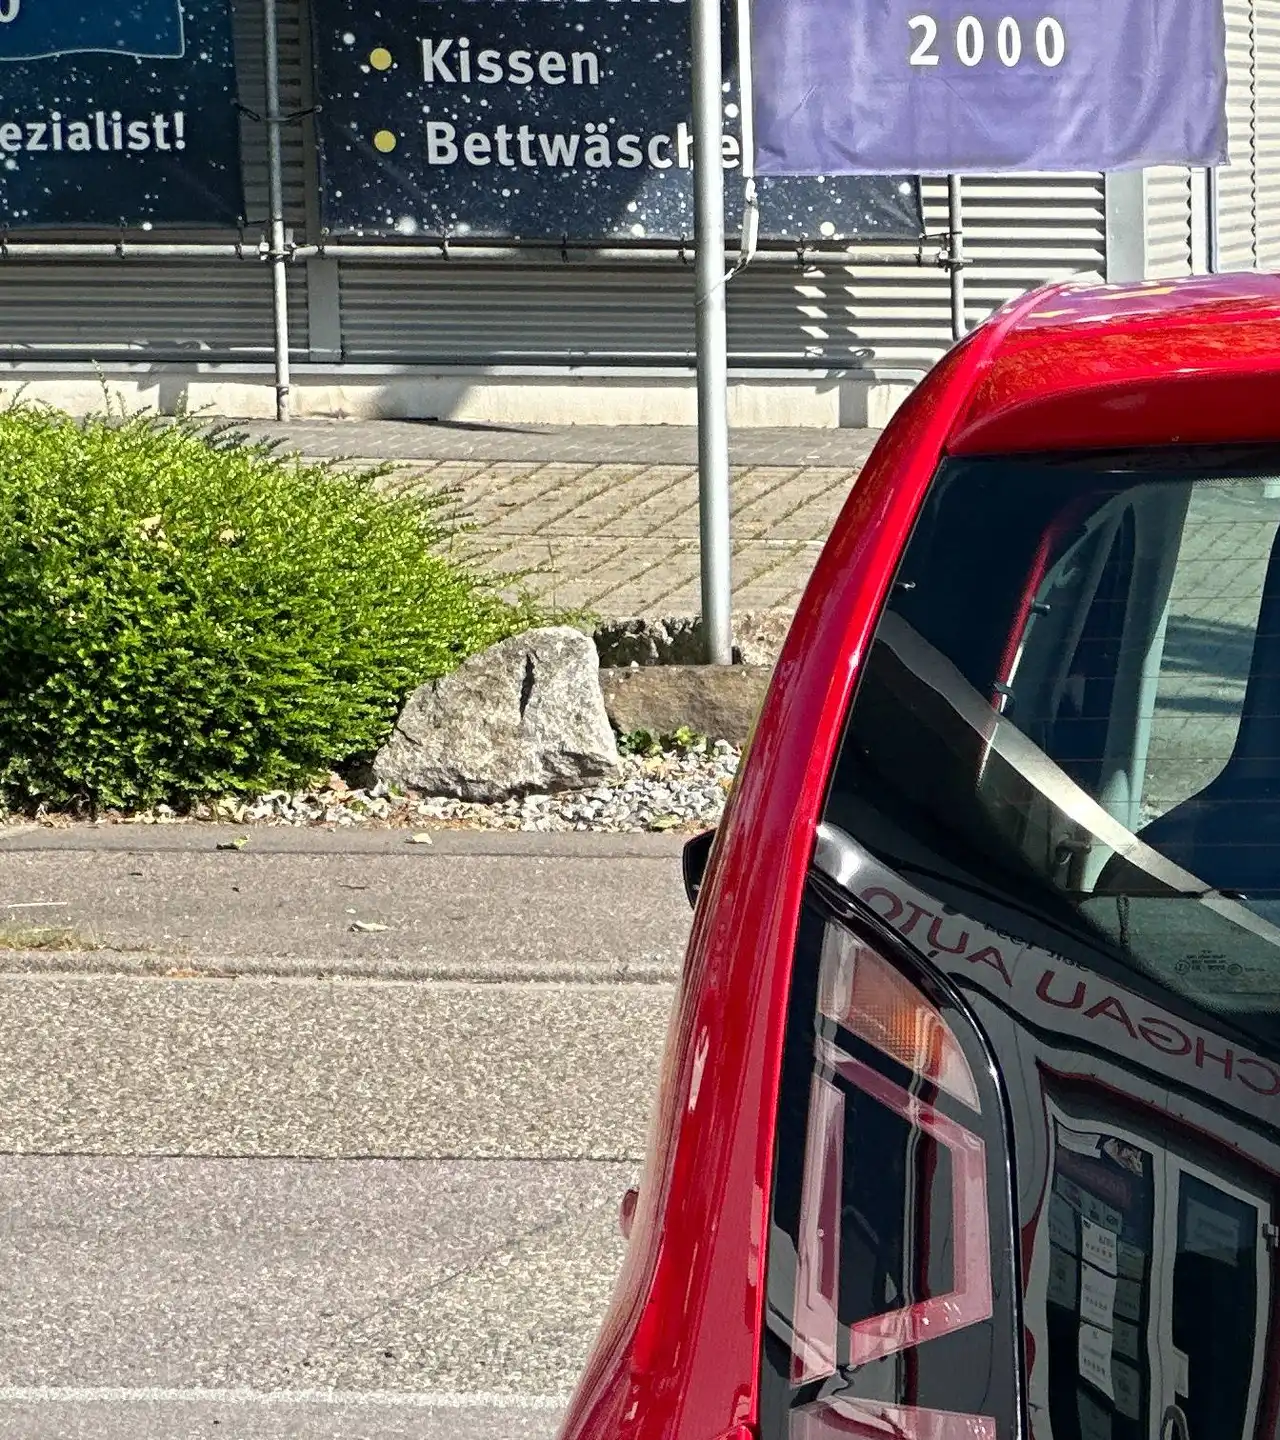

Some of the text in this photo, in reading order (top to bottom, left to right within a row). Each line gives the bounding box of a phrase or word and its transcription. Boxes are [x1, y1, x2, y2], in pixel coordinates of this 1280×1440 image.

[422, 37, 599, 84] Kissen
[907, 14, 1066, 67] 2000
[0, 111, 186, 151] ezialist!
[427, 121, 740, 169] Bettwäsche
